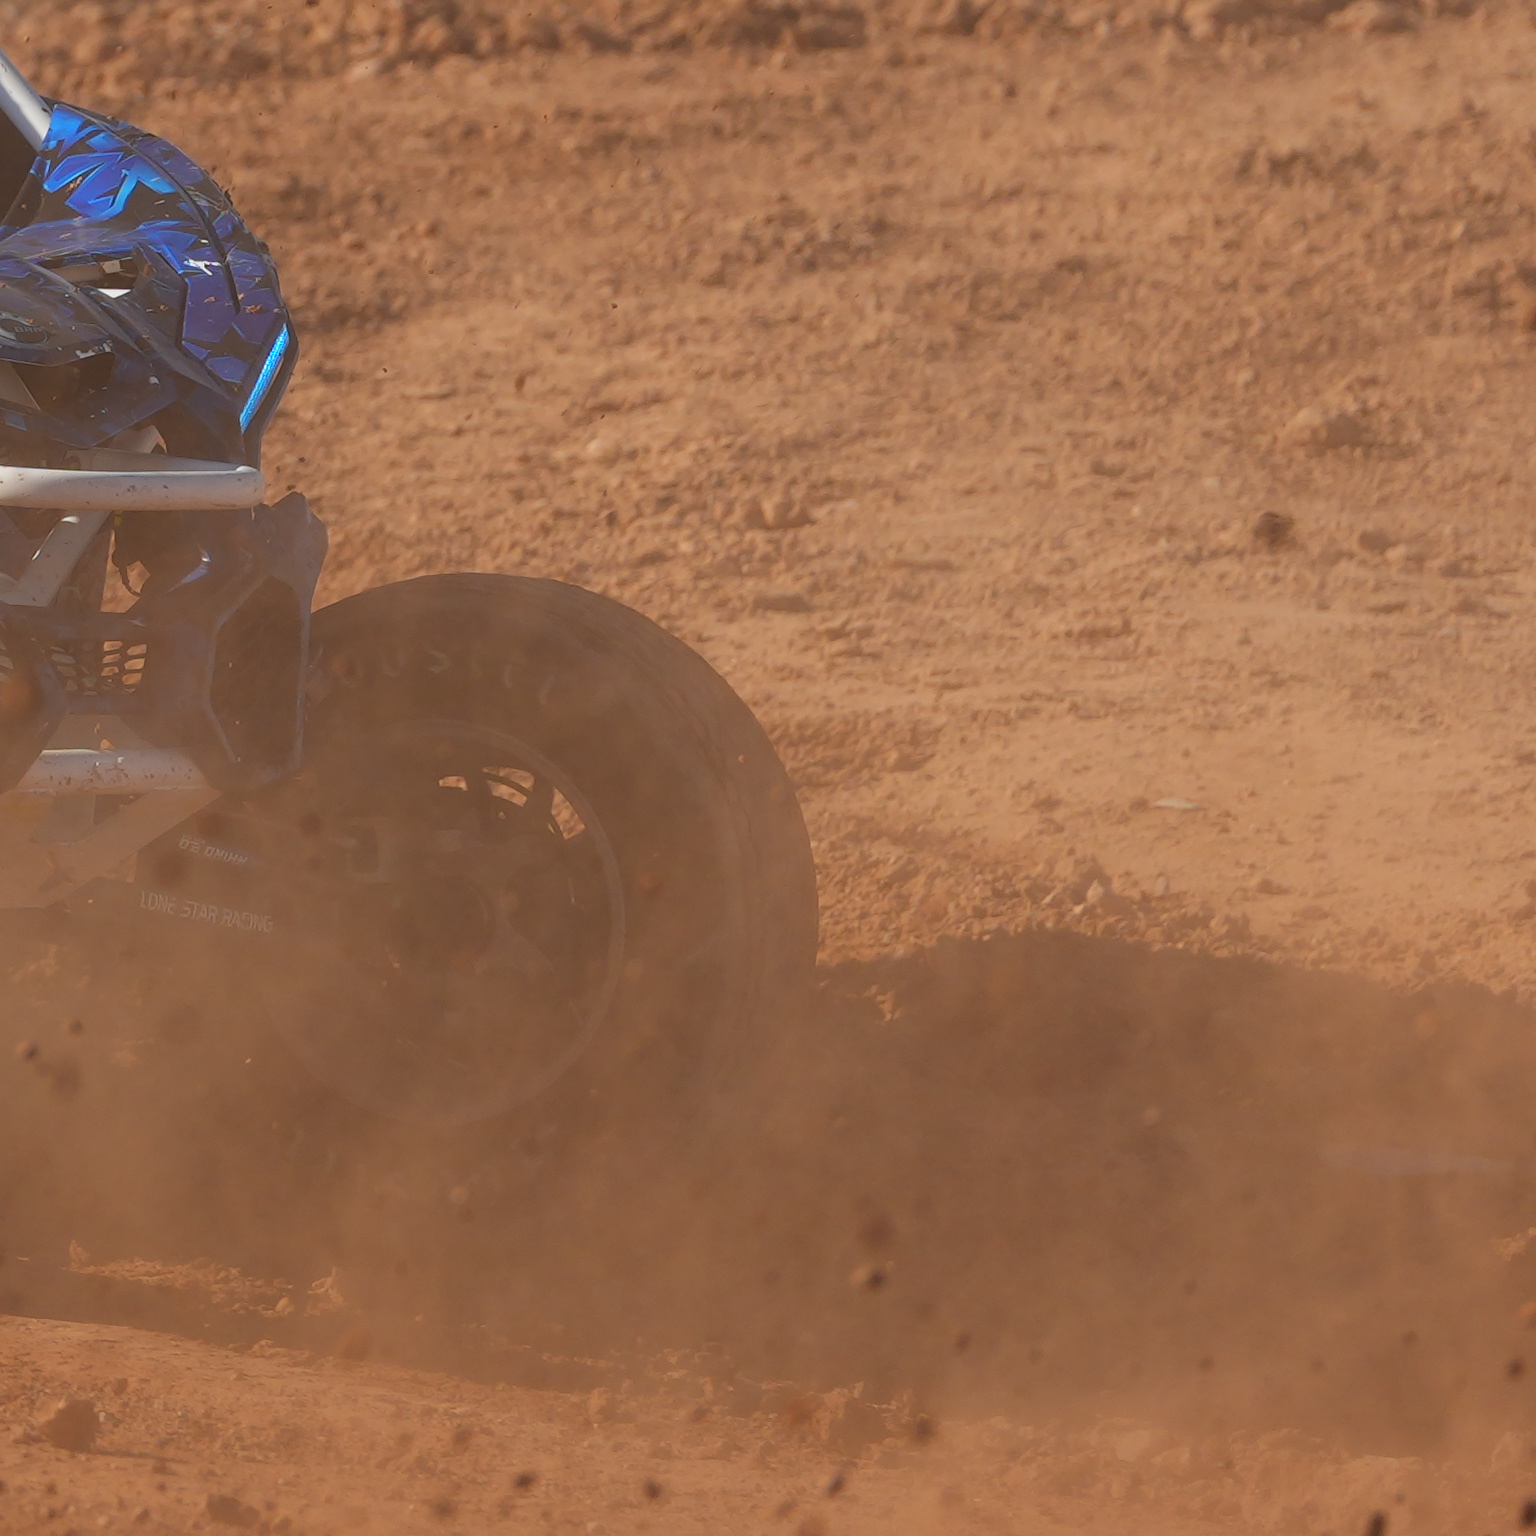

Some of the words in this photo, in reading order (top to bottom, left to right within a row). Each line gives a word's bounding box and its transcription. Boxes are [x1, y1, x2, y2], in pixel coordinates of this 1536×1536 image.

[139, 889, 178, 916] LONE
[179, 900, 219, 925] STAR
[220, 908, 274, 933] RACING
